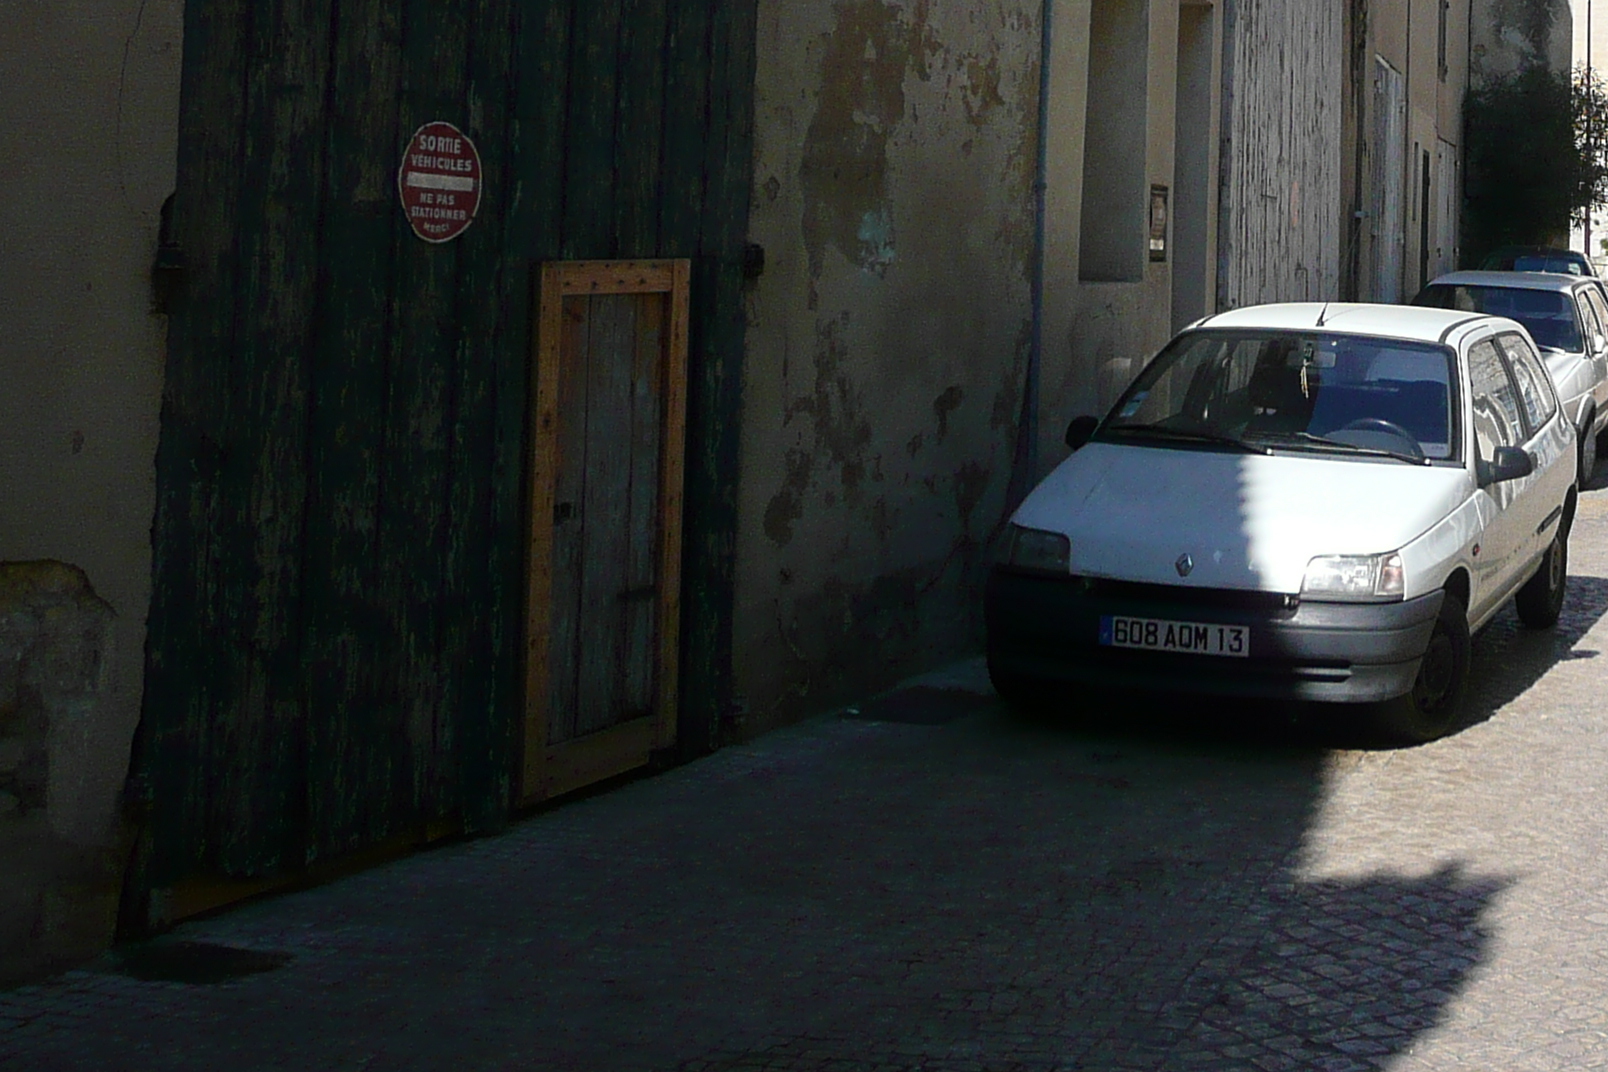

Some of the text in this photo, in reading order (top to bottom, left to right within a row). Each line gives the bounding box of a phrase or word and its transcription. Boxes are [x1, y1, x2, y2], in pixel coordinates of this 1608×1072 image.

[419, 135, 462, 154] SORTIE
[420, 193, 455, 206] NE PAS
[411, 206, 467, 221] STATIONNER
[423, 222, 450, 233] MERCI
[1114, 619, 1158, 646] 608
[1218, 627, 1243, 653] 13
